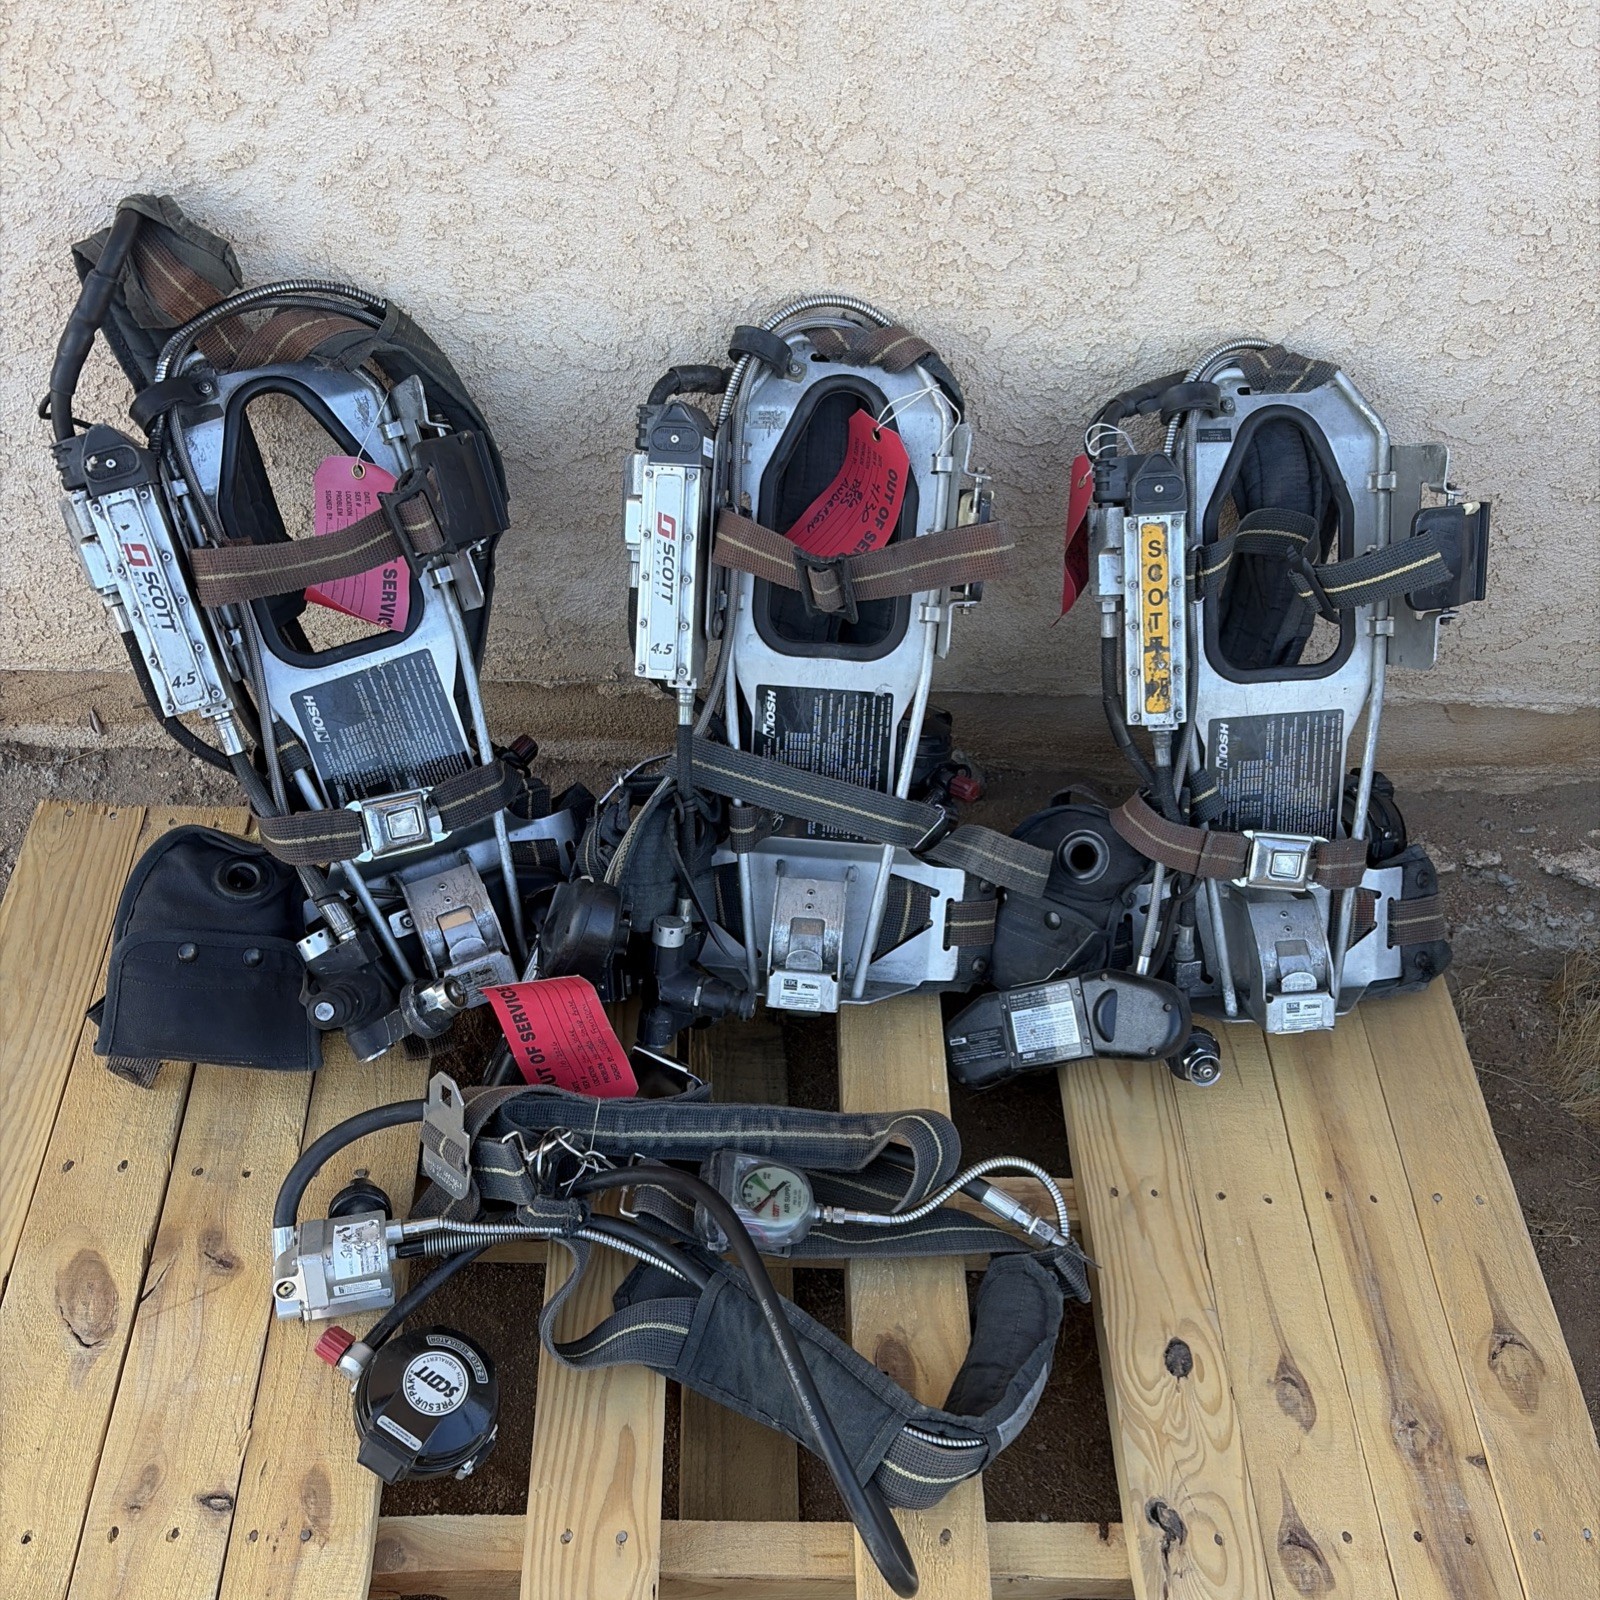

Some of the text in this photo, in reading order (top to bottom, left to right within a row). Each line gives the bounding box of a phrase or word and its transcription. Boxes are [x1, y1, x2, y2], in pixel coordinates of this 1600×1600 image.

[335, 490, 343, 516] PROBLEM
[345, 491, 353, 517] LOCATION
[887, 468, 898, 505] OUT
[875, 506, 890, 531] OF
[661, 542, 675, 606] SCOTT
[133, 571, 159, 629] SAFETY
[142, 571, 178, 633] SCOTT
[378, 568, 398, 629] SERVIC
[650, 642, 674, 656] 4.5
[171, 670, 197, 689] 4.5
[303, 695, 330, 744] NIOSH
[762, 690, 777, 739] NIOSH
[1215, 722, 1229, 770] NIOSH
[495, 986, 557, 1087] UT OF SERVICE
[426, 1356, 458, 1371] VIBRALERT
[429, 1337, 470, 1355] REGULATOR
[413, 1365, 461, 1399] SCOTT
[770, 1322, 784, 1347] MADE
[782, 1348, 790, 1360] IN
[801, 1395, 812, 1412] 250
[810, 1414, 822, 1431] PSI
